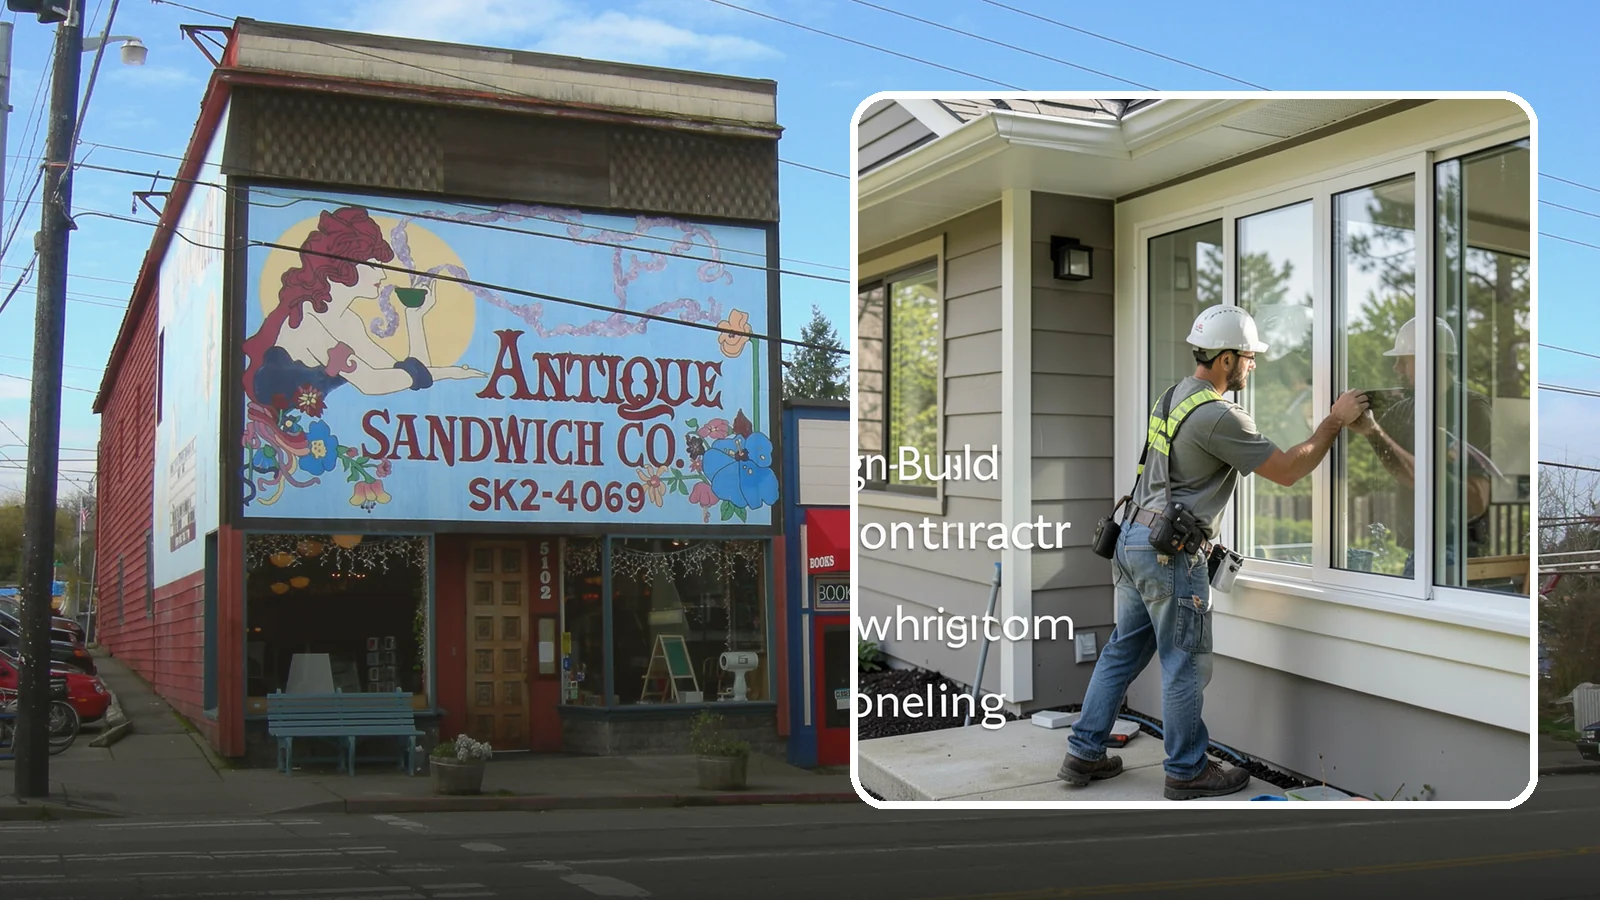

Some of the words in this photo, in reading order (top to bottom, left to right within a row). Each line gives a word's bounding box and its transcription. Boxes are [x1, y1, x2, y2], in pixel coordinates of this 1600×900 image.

[475, 329, 723, 421] ANTIQUE
[361, 408, 604, 467] SANDWICH
[617, 422, 685, 468] CO.
[468, 477, 645, 513] SK2-4069
[540, 541, 551, 600] 5102
[809, 555, 835, 568] BOOKS
